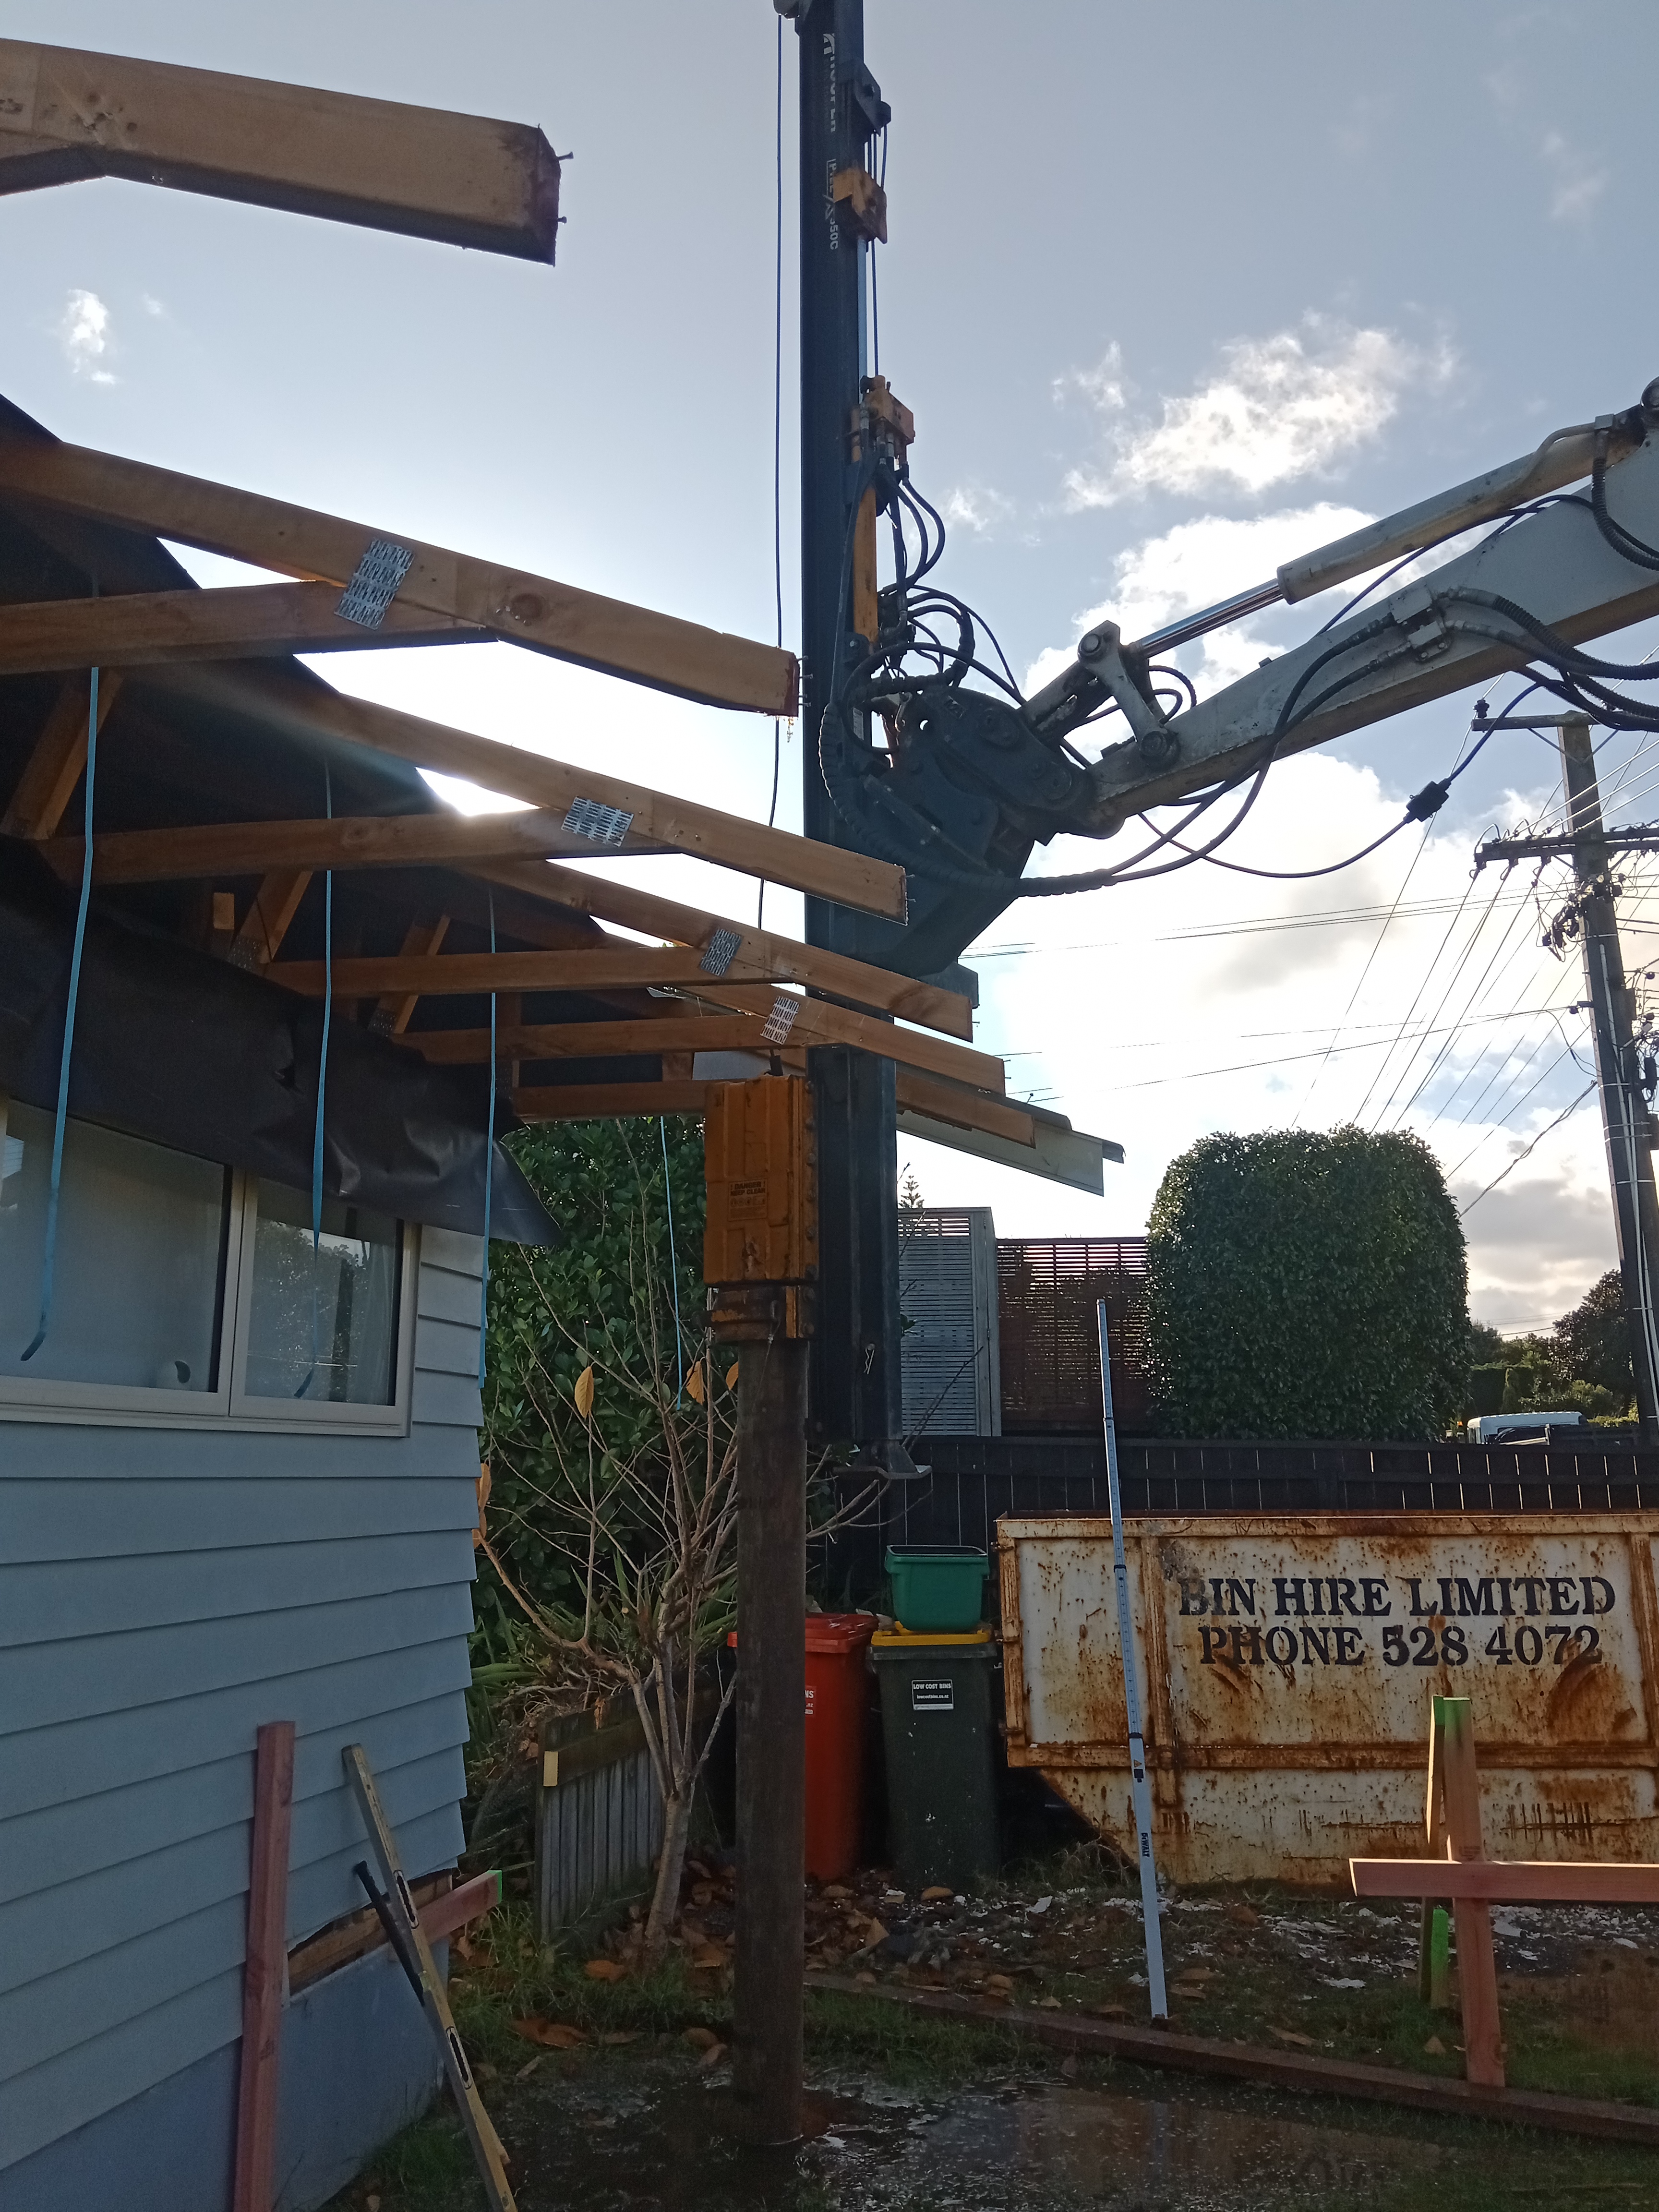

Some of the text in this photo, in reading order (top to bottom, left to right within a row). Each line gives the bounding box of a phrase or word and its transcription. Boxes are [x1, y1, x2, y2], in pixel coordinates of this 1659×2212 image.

[734, 1181, 762, 1190] DANGER
[1179, 1576, 1616, 1616] BIN HIRE LIMITED
[1197, 1624, 1603, 1666] PHONE 528 4072
